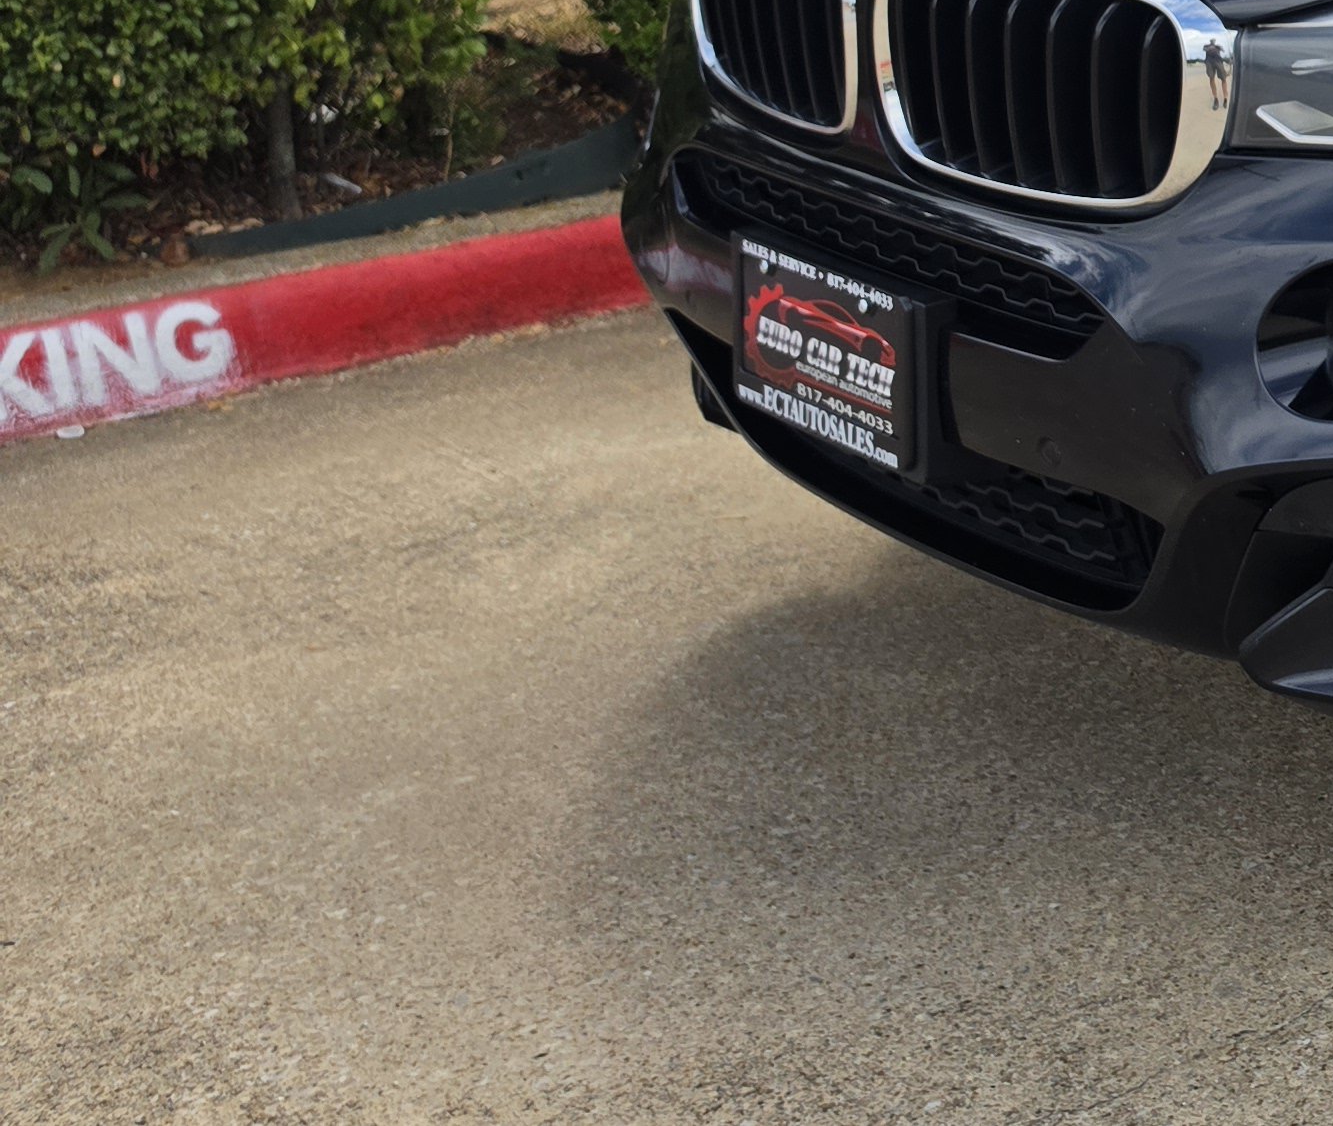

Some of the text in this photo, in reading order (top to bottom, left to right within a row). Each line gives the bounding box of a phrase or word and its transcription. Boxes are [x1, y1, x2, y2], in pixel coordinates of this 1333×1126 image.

[742, 238, 769, 261] SALES
[778, 252, 817, 280] SERVICE
[756, 315, 896, 397] EURO CAR TECH
[796, 361, 893, 410] european automotive
[797, 382, 894, 435] 817-404-4033
[737, 383, 899, 469] www.ECTAUTOSALES.com
